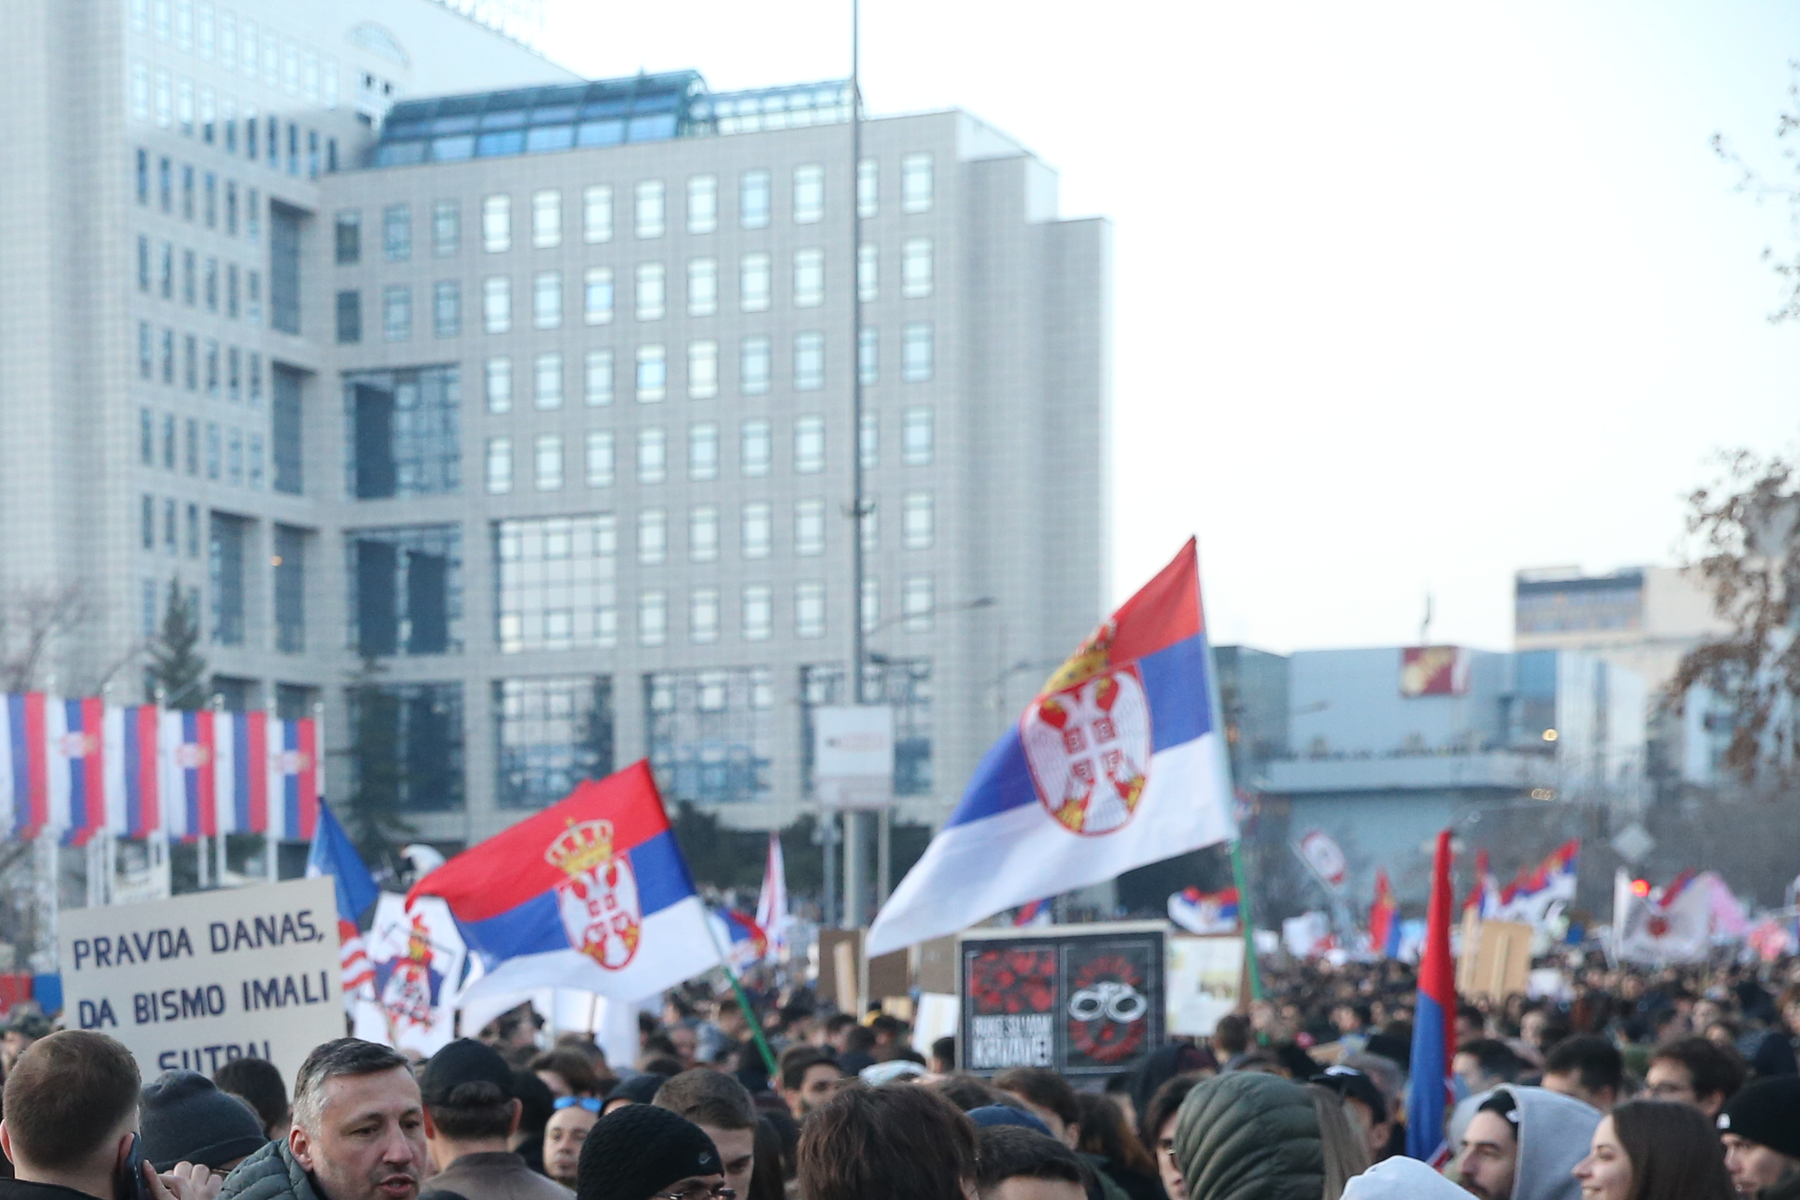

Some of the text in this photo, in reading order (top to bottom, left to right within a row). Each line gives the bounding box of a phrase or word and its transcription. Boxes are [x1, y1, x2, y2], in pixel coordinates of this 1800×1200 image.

[73, 910, 325, 970] PRAVDA DANAS,
[79, 971, 330, 1030] DA BISMO IMALI
